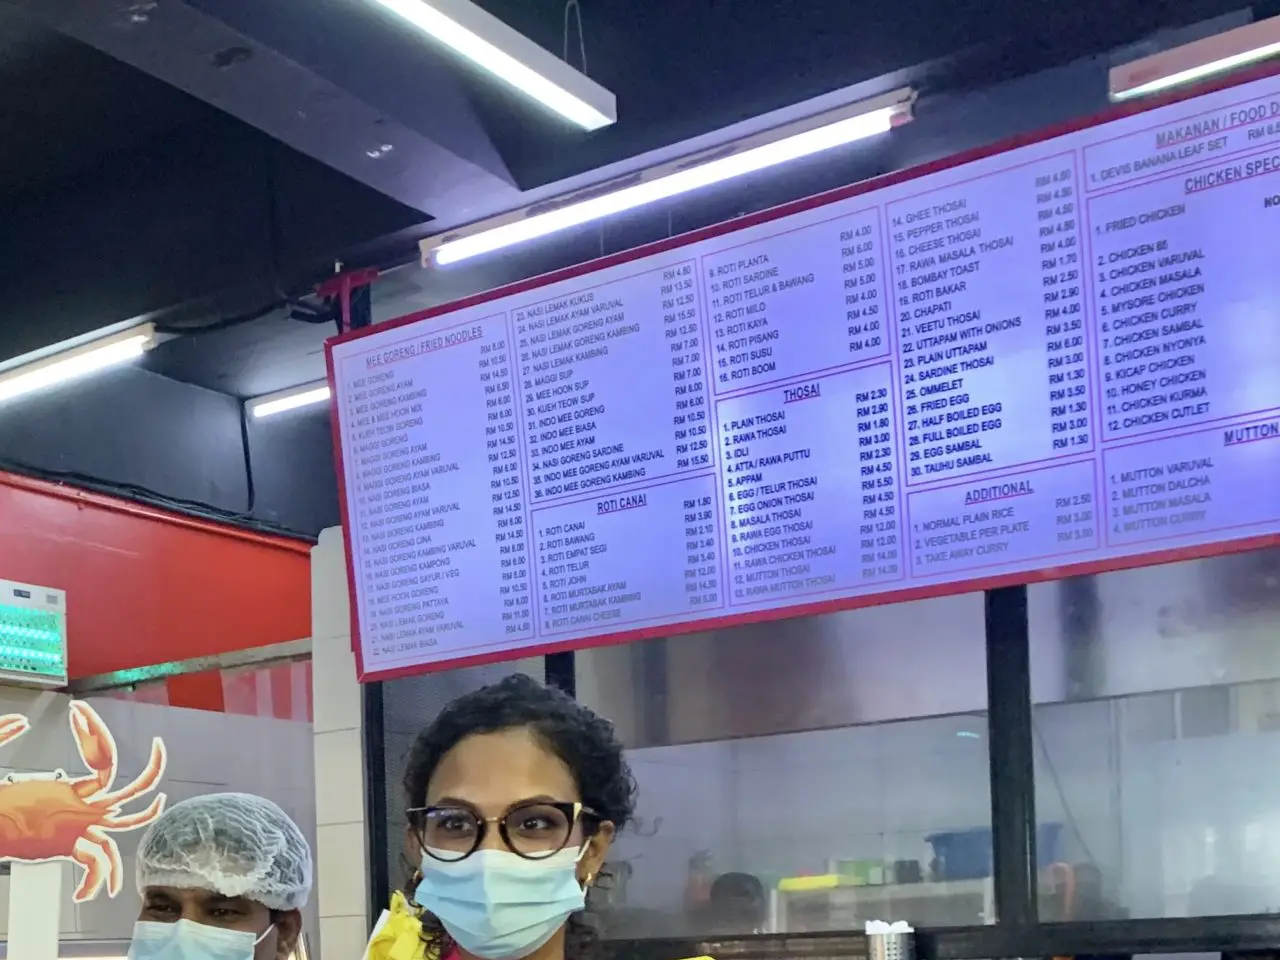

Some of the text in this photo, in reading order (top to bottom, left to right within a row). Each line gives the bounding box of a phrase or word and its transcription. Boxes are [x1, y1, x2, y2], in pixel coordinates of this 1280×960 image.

[1156, 116, 1219, 146] MAKANAN
[1230, 103, 1266, 126] FOOD
[1184, 164, 1242, 192] CHICKEN
[1111, 293, 1155, 313] MYSORE
[1158, 282, 1204, 303] CHICKEN
[366, 353, 381, 368] MEE
[383, 344, 415, 363] GORENG
[420, 336, 443, 353] FRIED
[445, 325, 482, 346] NOODLES
[716, 304, 878, 353] 14. ROTI PISANG RM 4.50
[902, 303, 1080, 353] 22. UTTAPAM WITH ONIONS RM 4.00
[917, 350, 943, 365] PLAIN
[945, 340, 987, 359] UTTAPAM
[1045, 324, 1061, 336] RM
[1063, 319, 1081, 332] 3.50
[783, 382, 820, 401] THOSAI
[919, 378, 963, 397] OMMELET
[1047, 356, 1063, 369] RM
[1065, 352, 1083, 365] 3.00
[920, 397, 947, 412] FRIED
[949, 393, 969, 406] EGG
[1048, 373, 1064, 385] RM
[1067, 368, 1084, 381] 1.30
[1121, 378, 1157, 395] HONEY
[1159, 368, 1206, 388] CHICKEN
[528, 404, 605, 430] 31. INDO MEE GORENG
[731, 417, 754, 430] PLAIN
[755, 410, 785, 425] THOSAI
[855, 391, 868, 403] RM
[870, 387, 887, 400] 2.30
[732, 431, 755, 444] RAWA
[756, 424, 786, 439] THOSAI
[856, 406, 869, 418] RM
[871, 402, 888, 414] 2.90
[921, 414, 944, 427] HALF
[946, 406, 979, 422] BOILED
[981, 402, 1002, 415] EGG
[1049, 389, 1064, 401] RM
[1067, 384, 1085, 398] 3.50
[922, 430, 944, 443] FULL
[946, 423, 979, 438] BOILED
[981, 418, 1001, 431] EGG
[1050, 405, 1065, 417] RM
[1068, 401, 1086, 414] 1.30
[734, 446, 748, 458] IDLI
[857, 421, 870, 432] RM
[734, 460, 753, 472] ATTA
[759, 454, 783, 467] RAWA
[783, 448, 810, 462] PUTTU
[859, 435, 872, 447] RM
[873, 431, 890, 444] 3.00
[923, 446, 943, 458] EGG
[945, 438, 981, 454] SAMBAL
[1051, 421, 1066, 433] RM
[1069, 417, 1087, 430] 3.00
[1224, 421, 1279, 443] MUTTON
[735, 472, 762, 486] APPAM
[859, 450, 872, 461] RM
[874, 446, 891, 458] 2.30
[737, 488, 754, 500] EGG
[760, 482, 785, 495] TELUR
[787, 476, 817, 490] THOSAI
[860, 464, 873, 476] RM
[875, 461, 892, 473] 4.50
[597, 493, 646, 512] ROTI CANAI
[737, 502, 755, 514] EGG
[756, 497, 782, 510] ONION
[784, 491, 814, 505] THOSAI
[861, 479, 874, 490] RM
[876, 475, 893, 487] 5.50
[739, 513, 770, 528] MASALA
[771, 508, 801, 522] THOSAI
[862, 493, 875, 505] RM
[877, 490, 894, 502] 4.50
[964, 479, 1033, 503] ADDITIONAL
[546, 538, 563, 549] ROTI
[564, 532, 595, 546] BAWANG
[684, 512, 696, 523] RM
[697, 509, 712, 520] 3.90
[739, 529, 763, 542] RAWA
[763, 526, 781, 537] EGG
[782, 520, 812, 534] THOSAI
[863, 508, 876, 519] RM
[878, 505, 894, 517] 4.50
